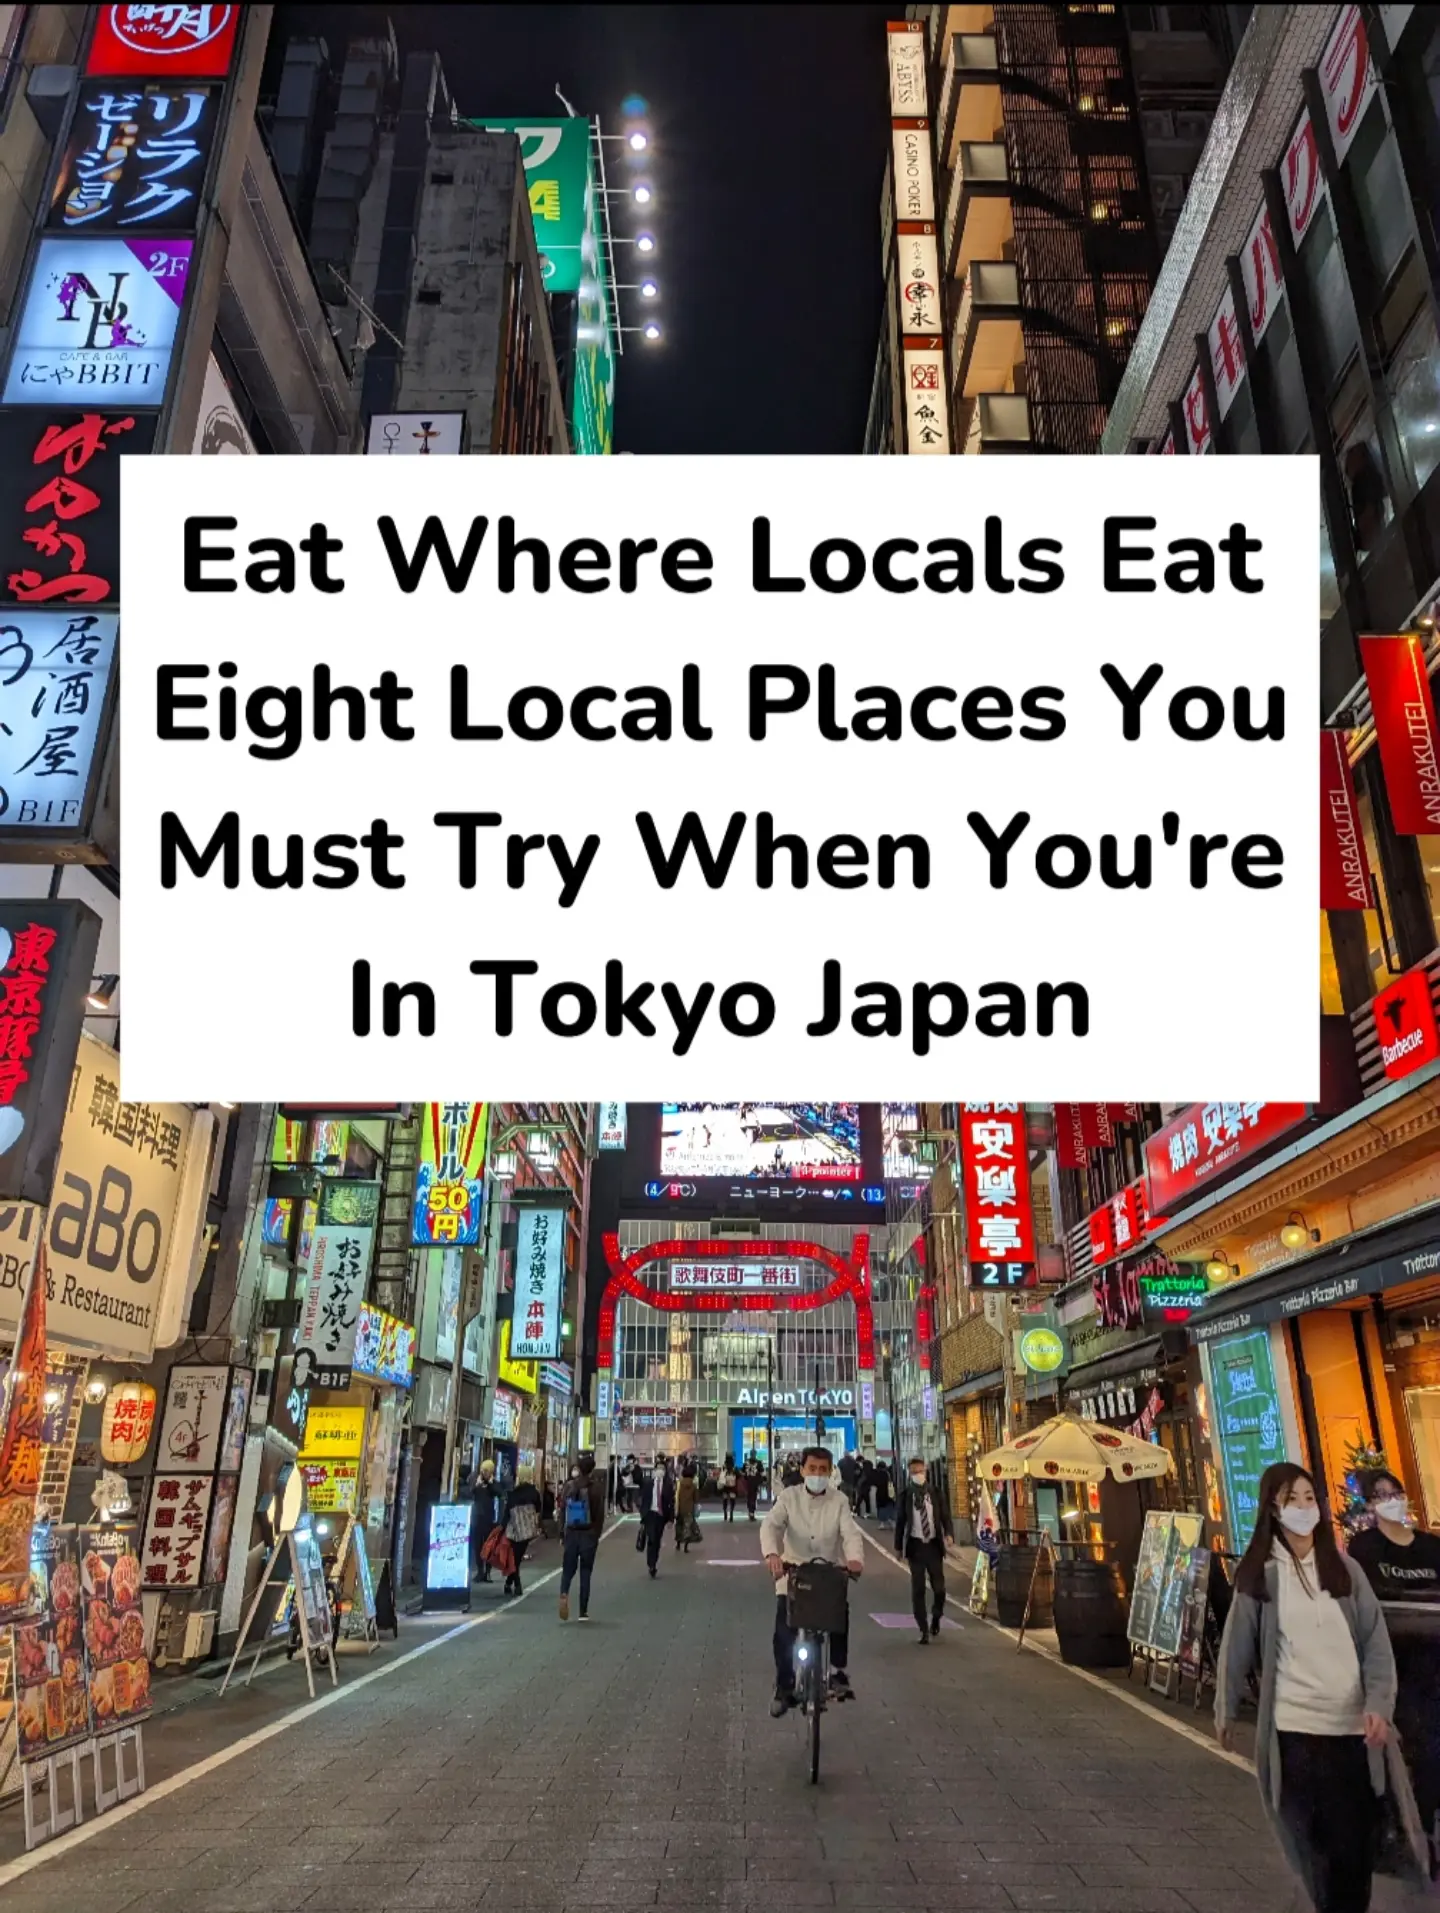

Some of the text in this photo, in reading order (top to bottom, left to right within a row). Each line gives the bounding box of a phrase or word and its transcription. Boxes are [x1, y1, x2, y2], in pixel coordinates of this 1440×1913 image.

[906, 23, 921, 32] 10
[917, 119, 926, 129] 9
[63, 93, 140, 227] ゼーション
[117, 93, 208, 225] リラク
[904, 133, 921, 216] CASINO POKER
[923, 224, 931, 235] 8
[149, 251, 189, 278] 2F
[929, 338, 939, 349] 7
[914, 404, 944, 444] 魚金
[13, 615, 103, 778] 居酒屋
[1404, 702, 1440, 825] ANRAKUTEI
[1331, 787, 1366, 903] ANRAKUTEI
[1382, 1029, 1423, 1066] Barbecue
[88, 1073, 181, 1172] 韓国料理
[432, 1214, 459, 1240] 円
[529, 1213, 549, 1295] お好み焼き
[675, 1266, 798, 1286] 歌舞伎町一番街
[982, 1262, 1023, 1285] 2F
[1140, 1276, 1205, 1293] Trattoria
[1344, 1278, 1359, 1293] Bar
[60, 1274, 151, 1329] Restaurant
[320, 1236, 362, 1352] お好み焼き
[1148, 1292, 1203, 1307] Pizzeria
[320, 1372, 349, 1387] B1F
[737, 1388, 796, 1408] Alpen
[110, 1398, 138, 1443] 焼肉
[143, 1479, 181, 1584] 韓国料理
[170, 1479, 207, 1584] サムギョプサル
